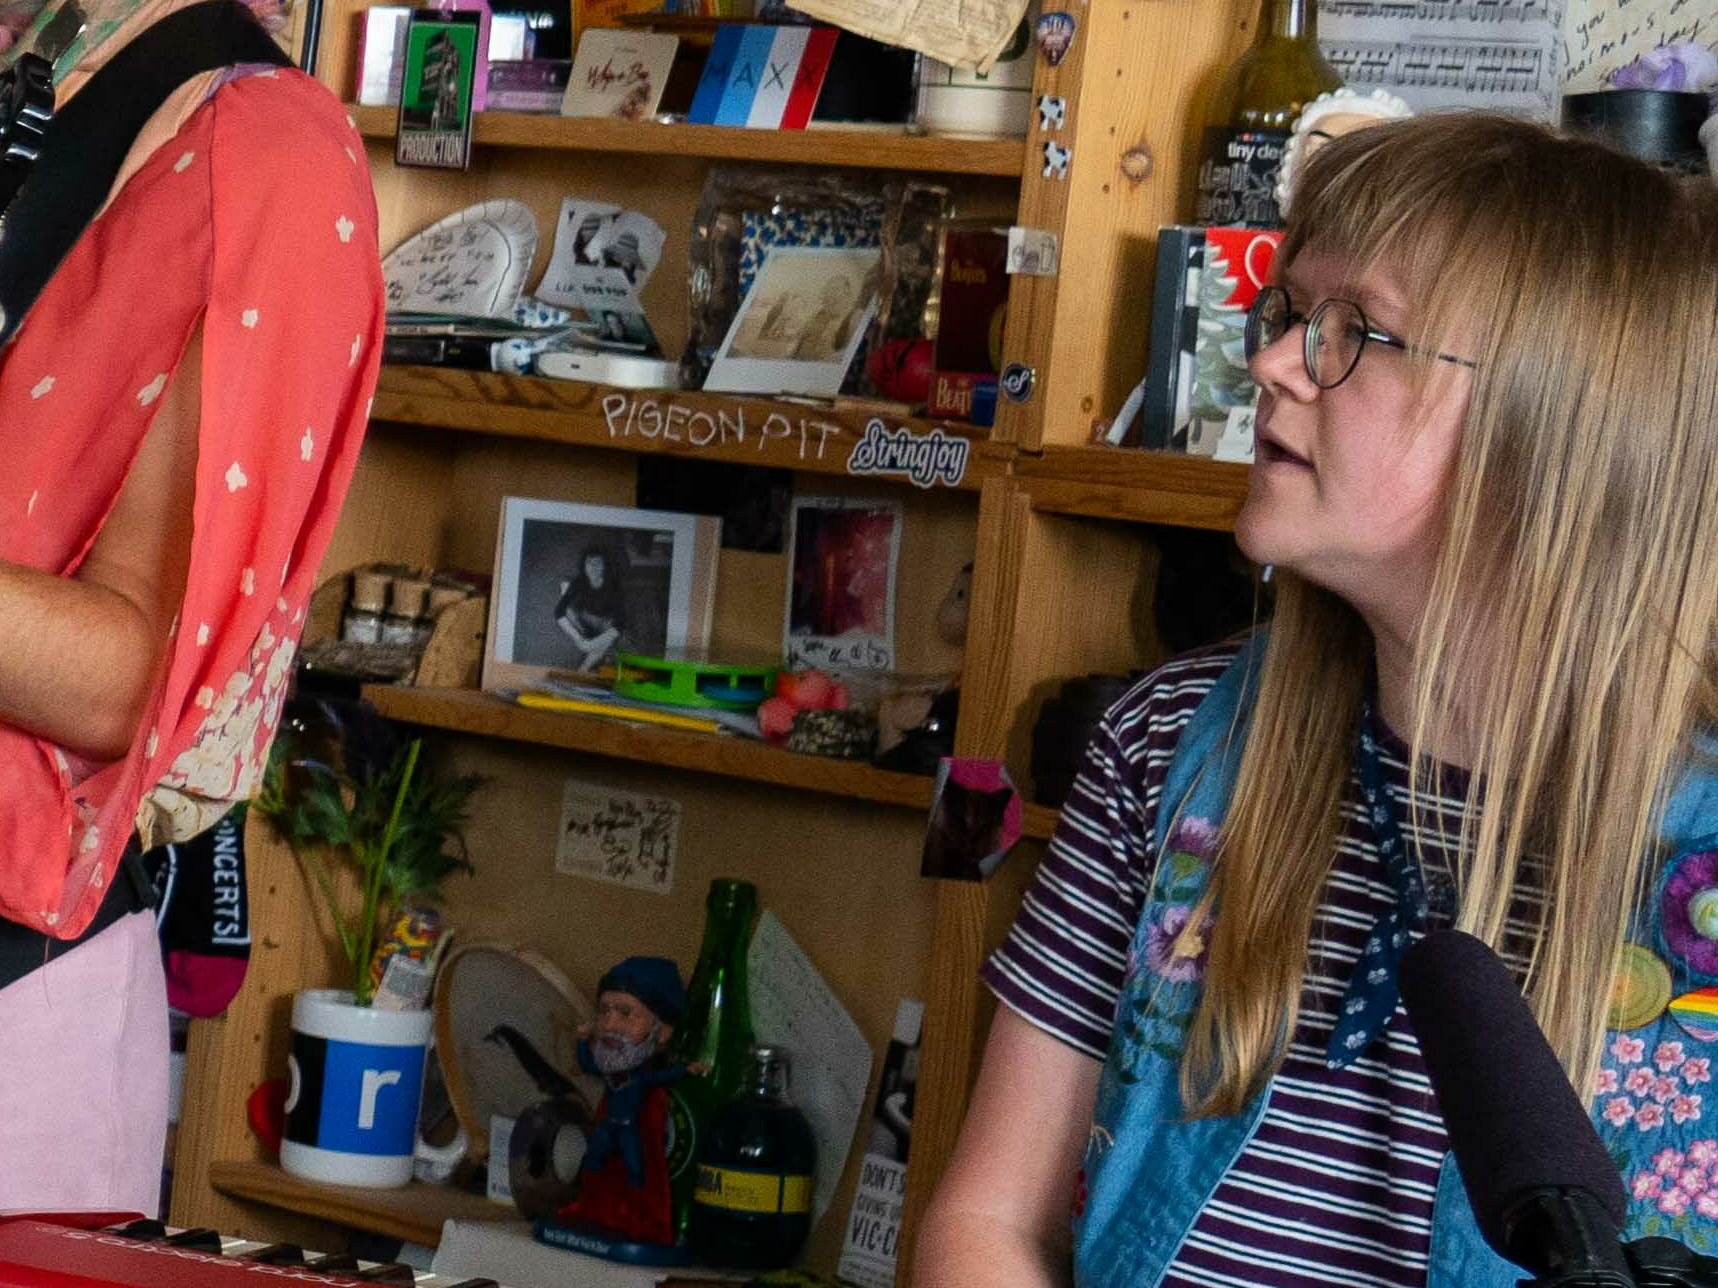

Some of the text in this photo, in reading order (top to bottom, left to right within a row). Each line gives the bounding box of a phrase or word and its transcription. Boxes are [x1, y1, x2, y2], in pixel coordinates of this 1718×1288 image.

[399, 136, 462, 165] PRODUCTION
[1227, 141, 1255, 163] tiny
[602, 394, 841, 460] PIGEON PIT
[850, 420, 968, 486] Stringjoy
